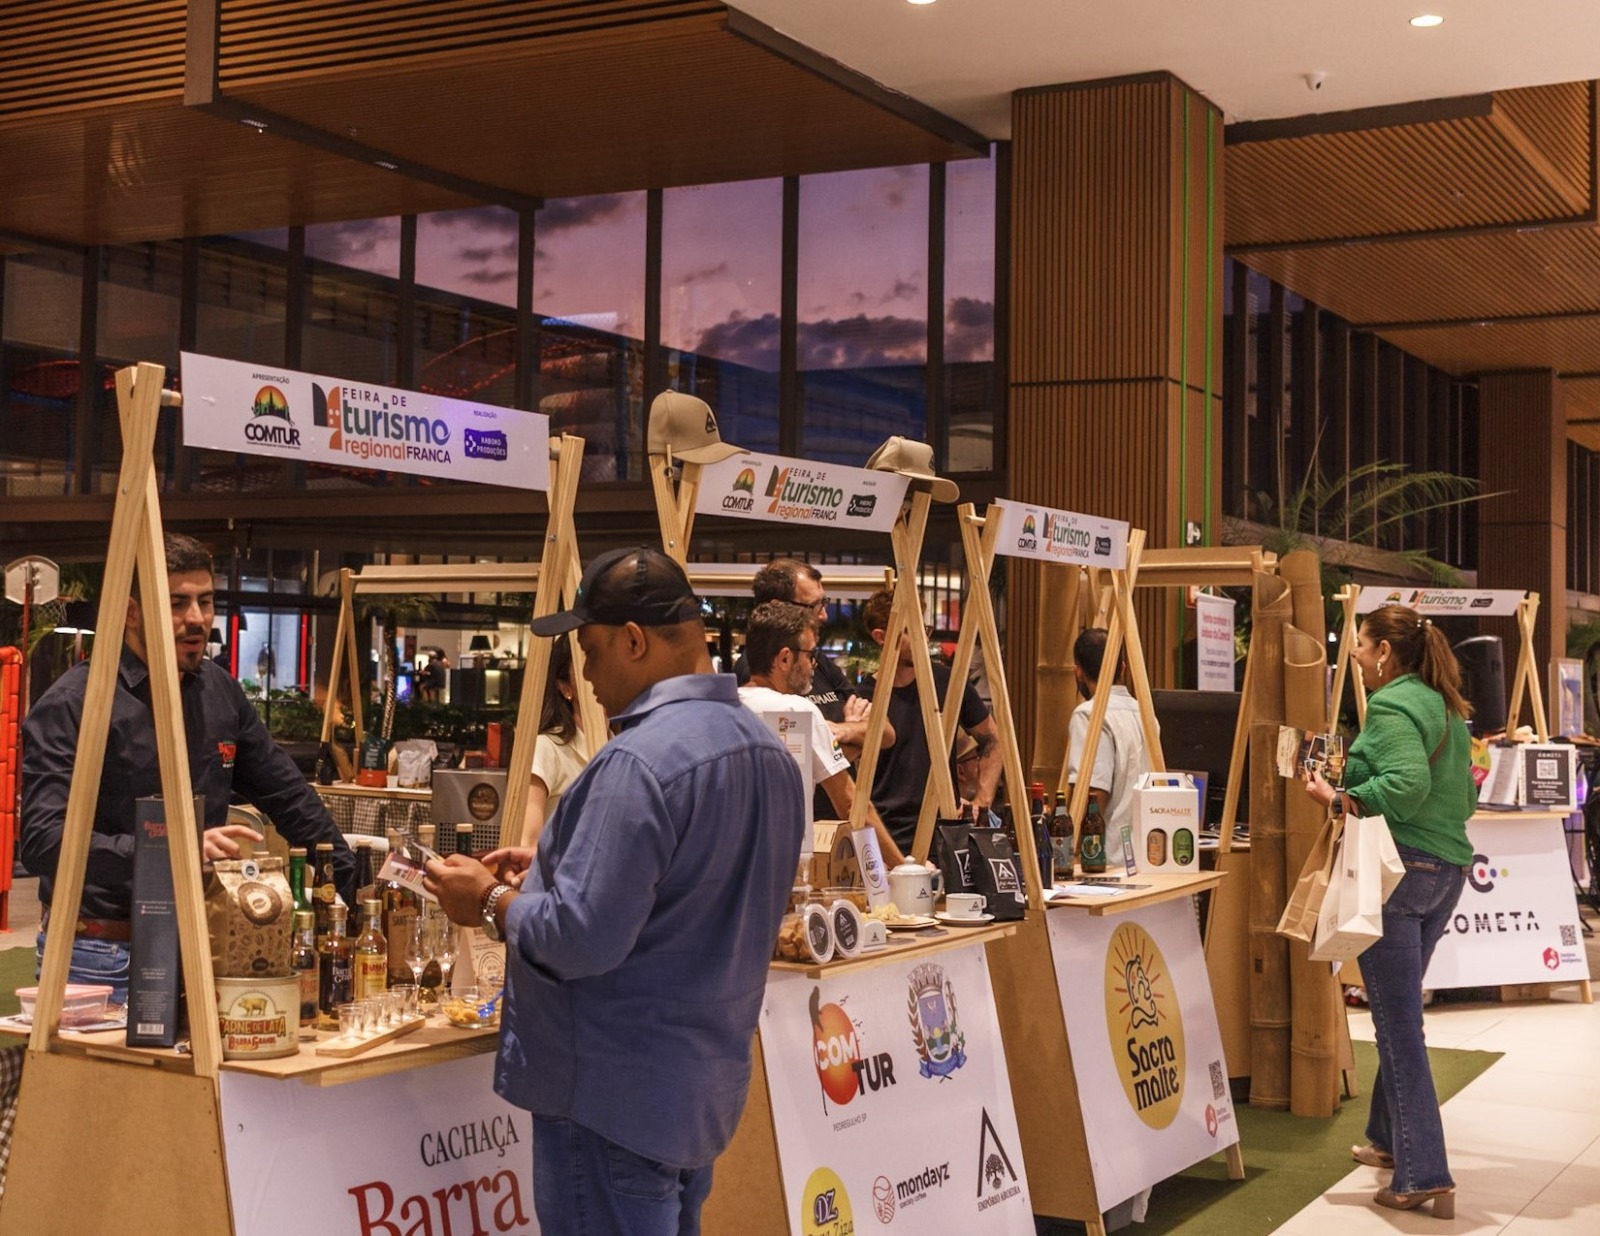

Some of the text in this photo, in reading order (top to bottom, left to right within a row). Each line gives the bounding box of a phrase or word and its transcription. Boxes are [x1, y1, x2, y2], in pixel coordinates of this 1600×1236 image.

[342, 387, 407, 407] FEIRA DE
[244, 423, 301, 446] COMTUR
[342, 399, 452, 446] turismo
[788, 467, 827, 481] FEIRA DE
[721, 495, 755, 512] COMTUR
[781, 476, 844, 508] turismo
[1053, 520, 1091, 548] turismo
[1420, 593, 1467, 605] turismo
[1443, 911, 1540, 934] OMETA
[815, 1031, 859, 1071] COM
[1127, 1035, 1176, 1077] Sacra
[852, 1052, 896, 1096] TUR
[1134, 1066, 1180, 1111] malte
[420, 1114, 520, 1167] CACHAÇA
[897, 1163, 950, 1200] mondayz
[348, 1169, 530, 1236] Barra
